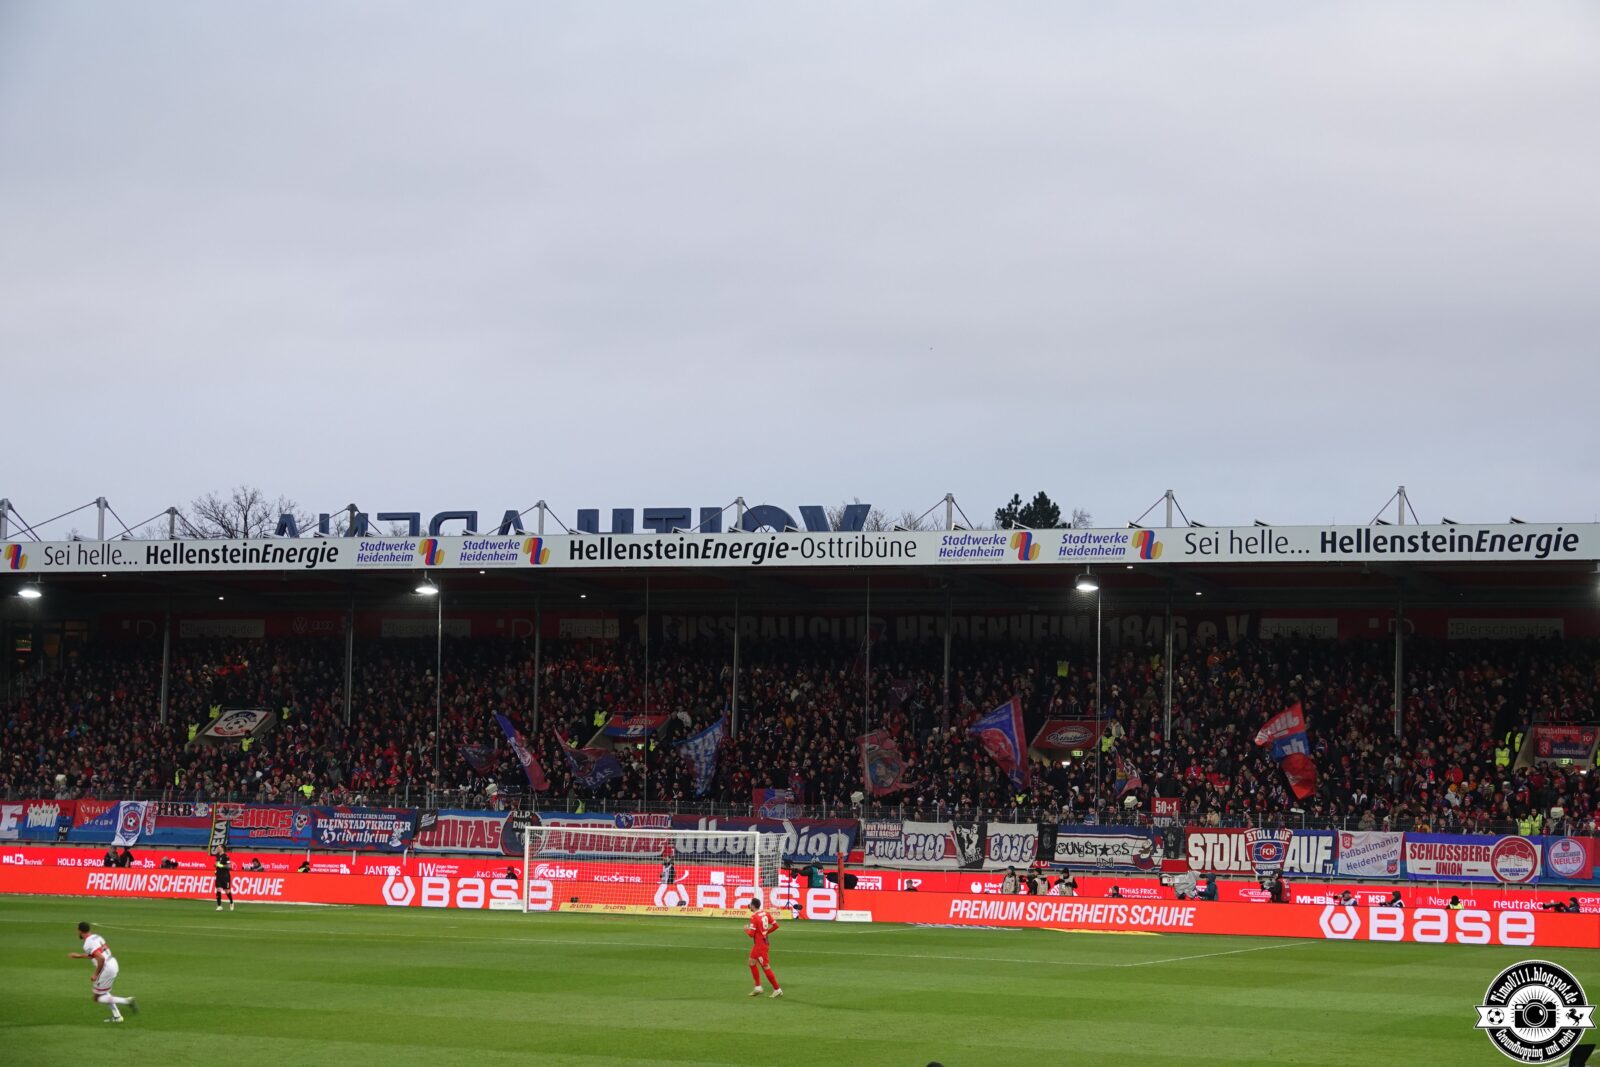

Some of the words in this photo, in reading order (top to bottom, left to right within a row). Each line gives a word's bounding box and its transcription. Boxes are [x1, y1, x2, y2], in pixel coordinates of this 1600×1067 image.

[942, 534, 1007, 546] Stadtwerke
[1062, 532, 1128, 544] Stadtwerke
[1184, 531, 1219, 555] Sei
[1230, 529, 1310, 555] helle...
[1320, 527, 1579, 558] HellensteinEnergie
[359, 541, 416, 552] Stadtwerke
[462, 539, 520, 551] Stadtwerke
[570, 535, 917, 565] HellensteinEnergie-Osttribüne
[1058, 544, 1126, 556] Heidenheim
[44, 544, 70, 565] Sei
[77, 543, 138, 565] helle...
[146, 541, 339, 568] HellensteinEnergie
[357, 552, 414, 563] Heidenheim
[460, 550, 518, 562] Heidenheim
[939, 547, 1004, 558] Heidenheim
[157, 803, 192, 817] HRB
[1155, 800, 1177, 814] 50+1
[317, 818, 411, 831] KLEINSTADTKRIEGER
[1246, 829, 1272, 842] STOLL
[1273, 829, 1291, 841] AUF
[1188, 833, 1253, 871] STOLL
[1284, 836, 1333, 873] AUF
[1261, 847, 1275, 856] FCH
[1340, 836, 1399, 859] Fußballmania
[1410, 843, 1491, 862] SCHLOSSBERG
[57, 858, 76, 867] HOLD
[77, 859, 82, 867] &
[1346, 848, 1398, 870] Heidenheim
[1554, 857, 1581, 865] NEULER
[419, 862, 436, 876] IW
[1435, 862, 1462, 875] UNION
[86, 873, 148, 892] PREMIUM
[231, 878, 284, 896] SCHUHE
[1140, 888, 1158, 896] FRICK
[1368, 894, 1386, 904] MSR
[1428, 896, 1477, 908] Neuann
[949, 899, 1024, 921] PREMIUM
[1026, 902, 1127, 925] SICHERHEITS
[1129, 905, 1197, 927] SCHUHE
